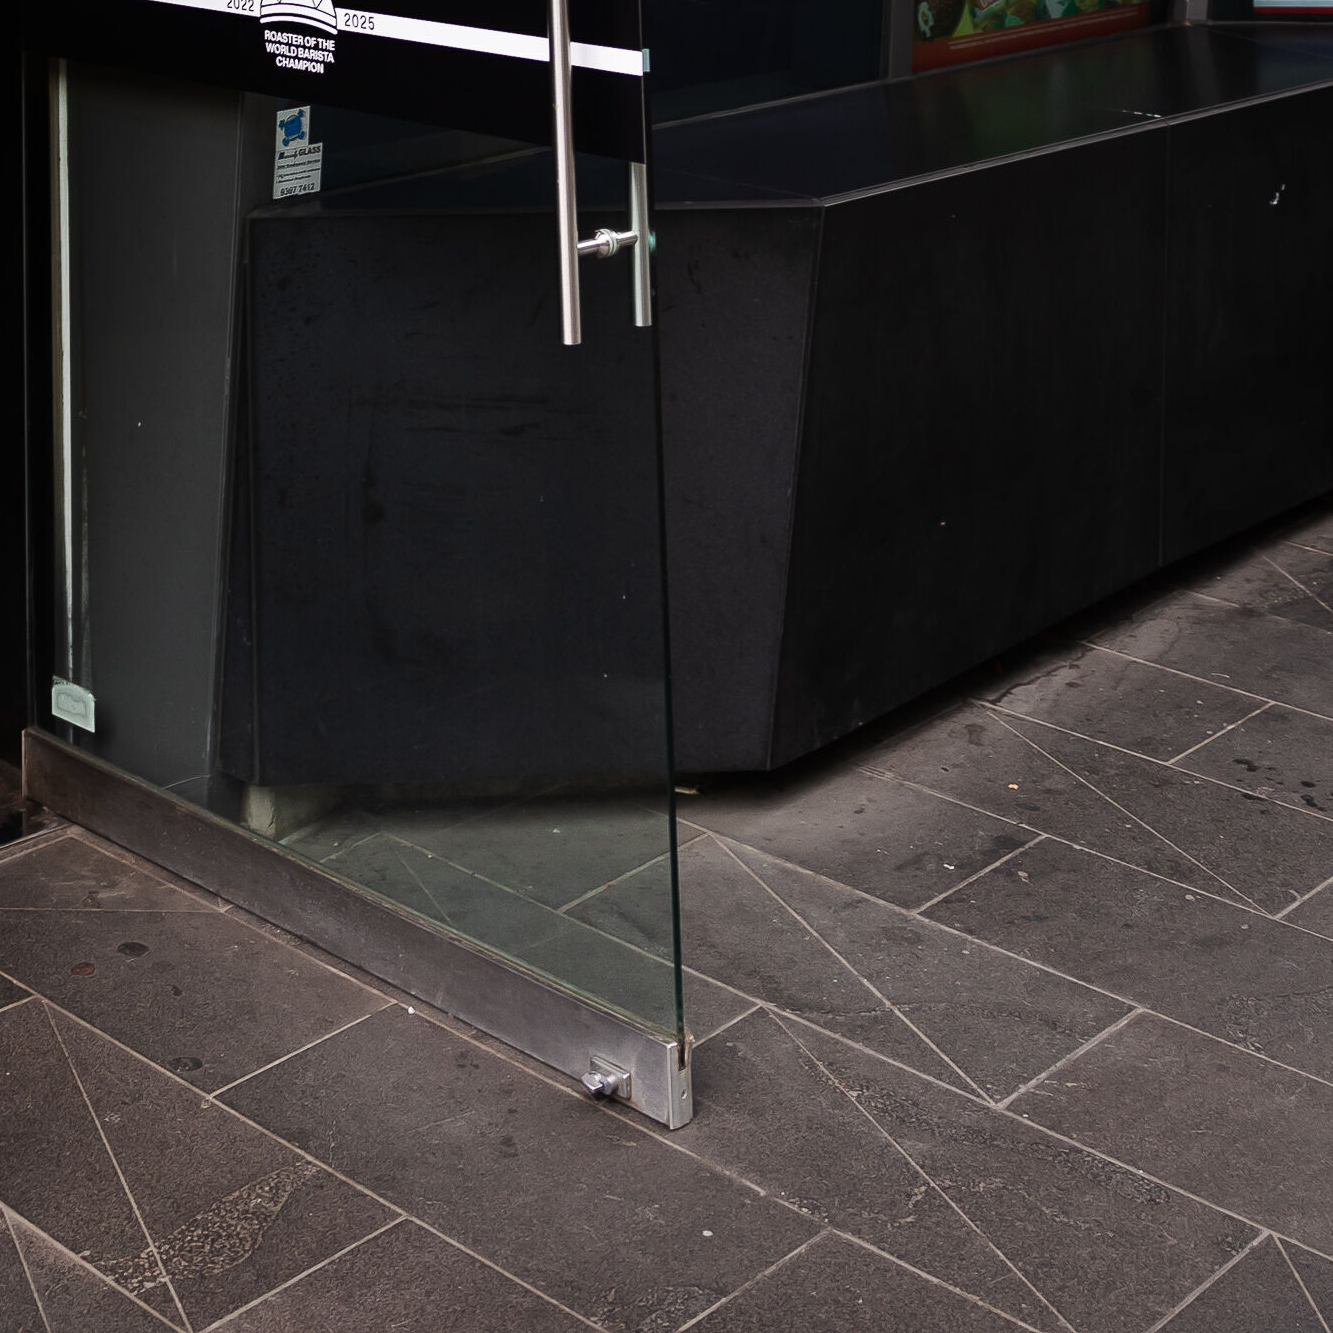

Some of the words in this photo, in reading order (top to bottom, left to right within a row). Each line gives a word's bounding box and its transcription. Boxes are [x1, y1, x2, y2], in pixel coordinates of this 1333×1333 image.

[343, 12, 376, 31] 2025
[264, 29, 304, 46] ROASTER
[304, 36, 317, 47] OF
[316, 37, 336, 52] THE
[265, 42, 298, 58] WORLD
[297, 47, 335, 64] BARISTA
[275, 55, 325, 75] CHAMPION
[298, 145, 321, 157] GLASS
